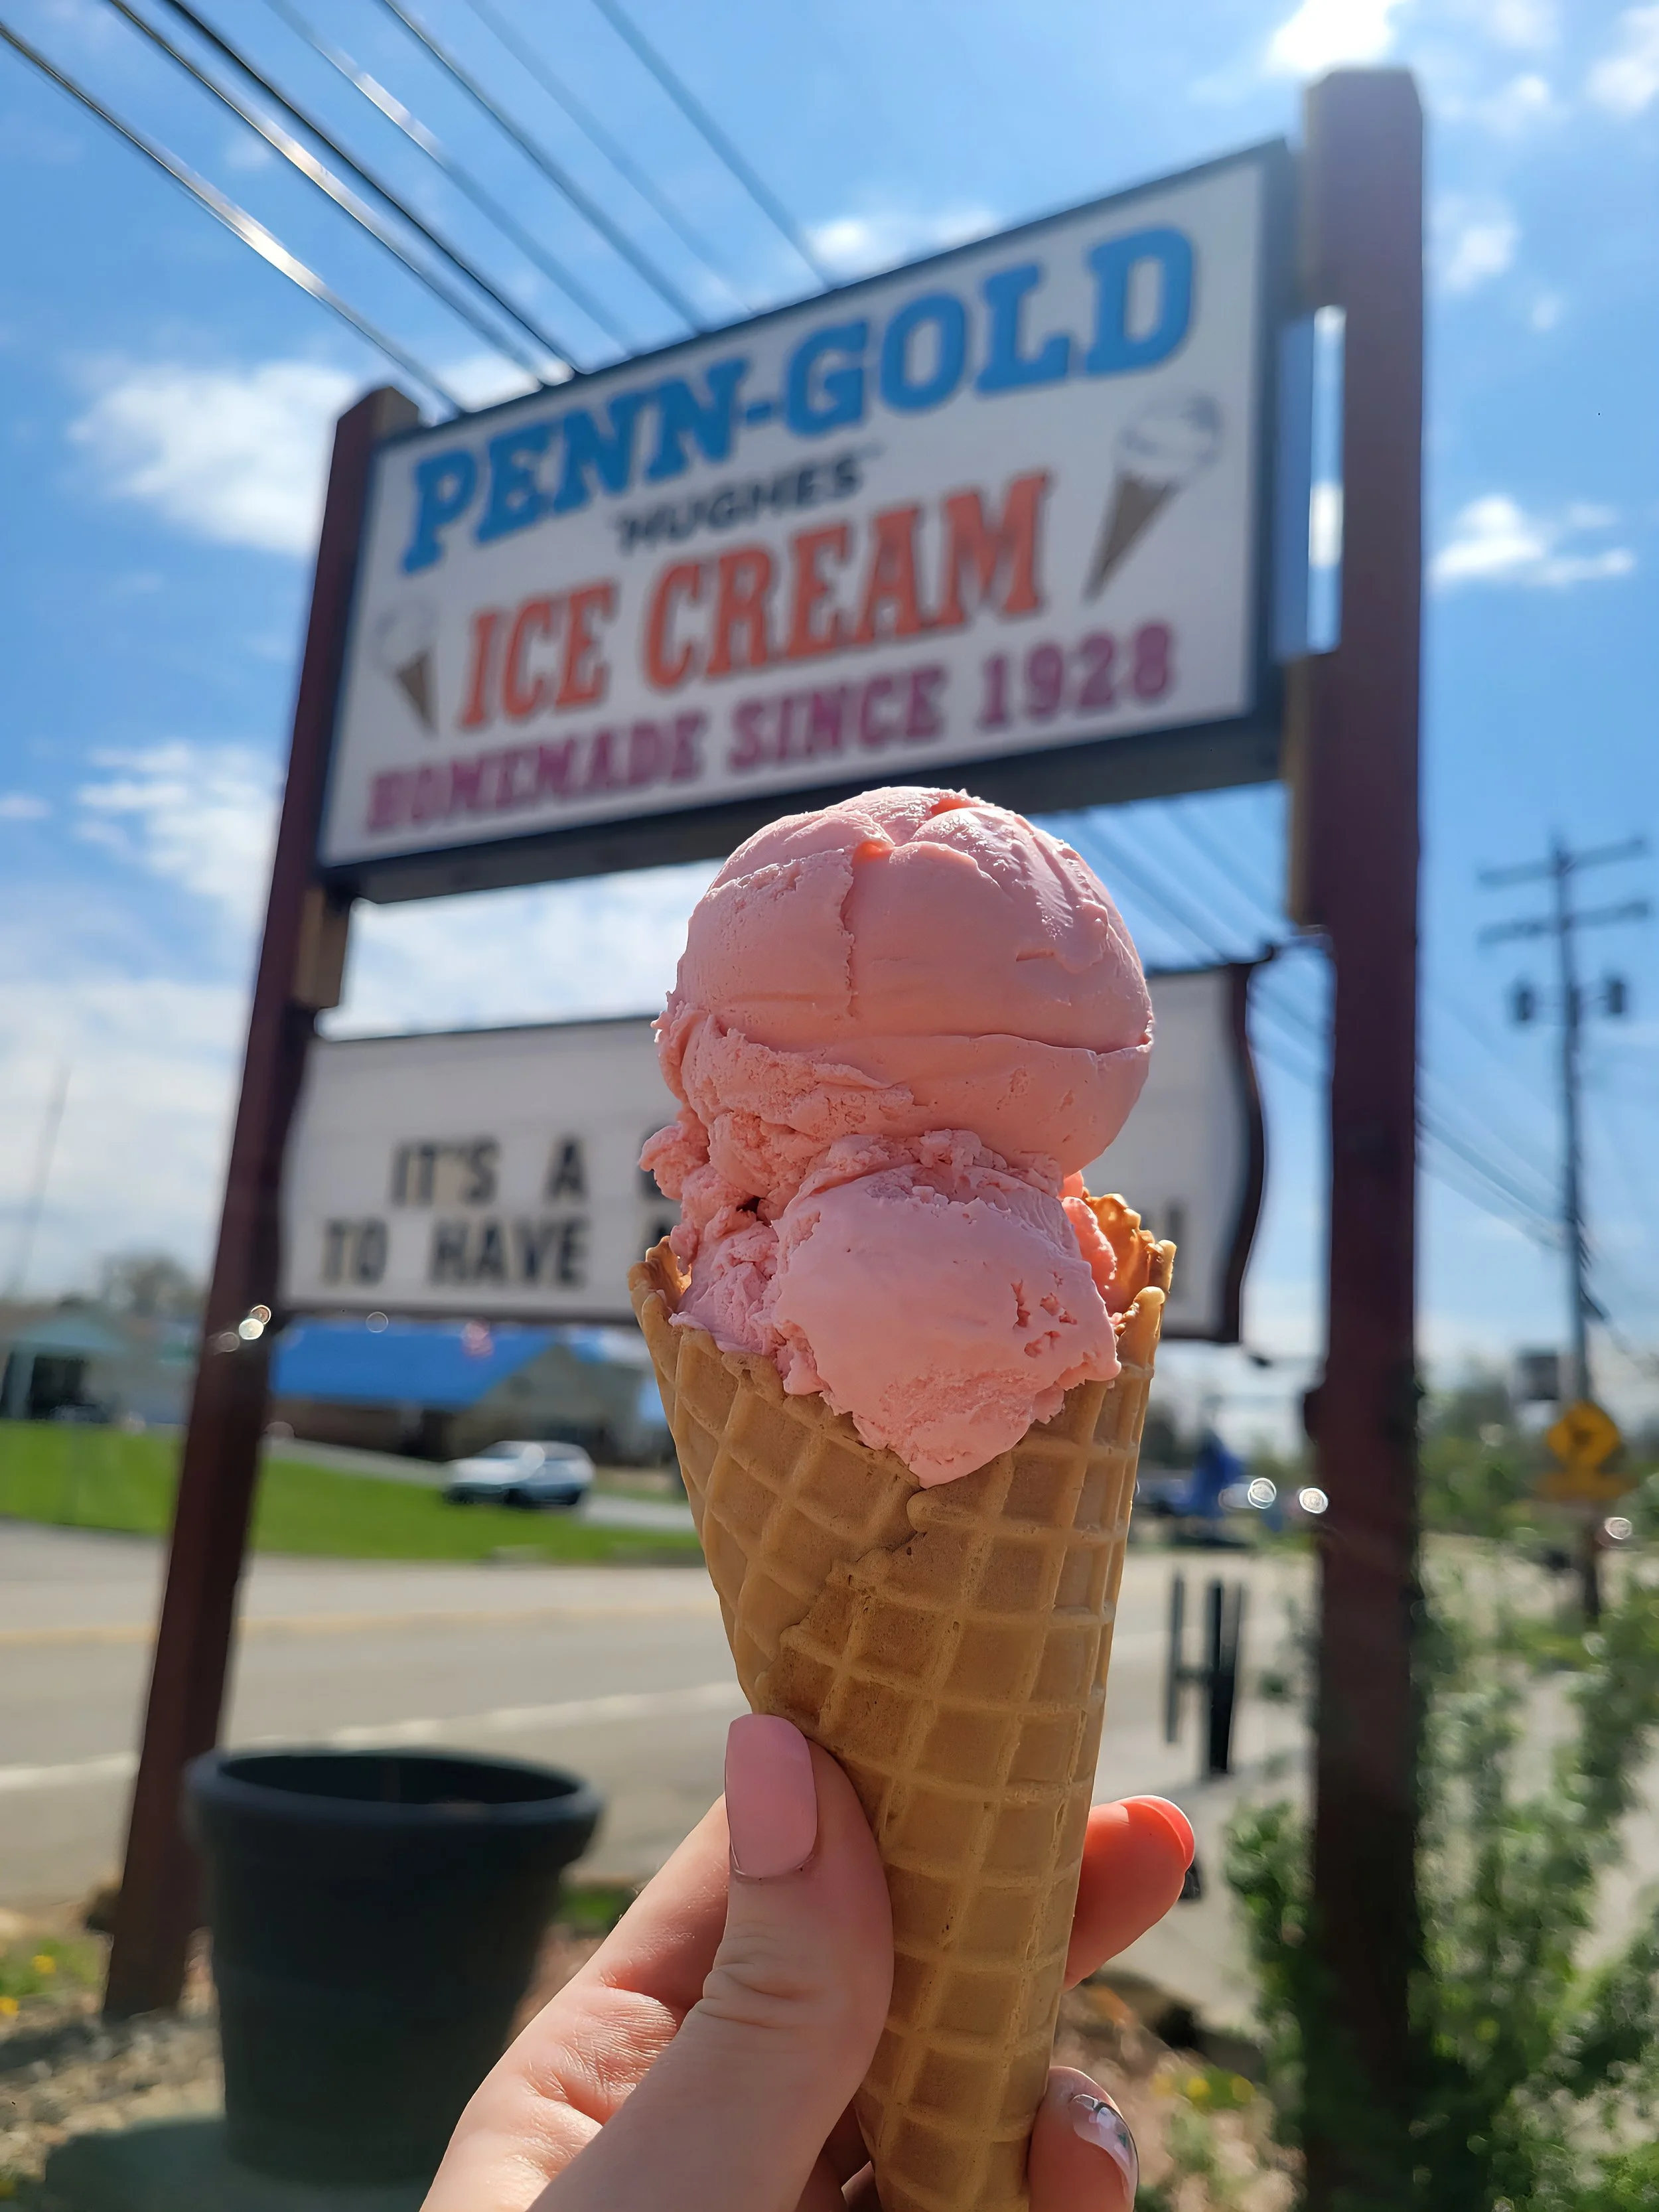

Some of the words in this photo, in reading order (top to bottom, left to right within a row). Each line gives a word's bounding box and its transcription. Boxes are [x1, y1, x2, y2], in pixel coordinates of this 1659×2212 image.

[401, 225, 1196, 575] PENN-GOLD
[459, 579, 618, 731] ICE
[644, 471, 1056, 700] CREAM
[367, 706, 707, 835] HOMEMADE
[726, 654, 948, 772] SINCE
[977, 619, 1177, 734] 1928
[323, 1217, 390, 1289] TO
[428, 1217, 589, 1289] HAVE
[390, 1134, 501, 1208] IT'S
[543, 1134, 589, 1205] A
